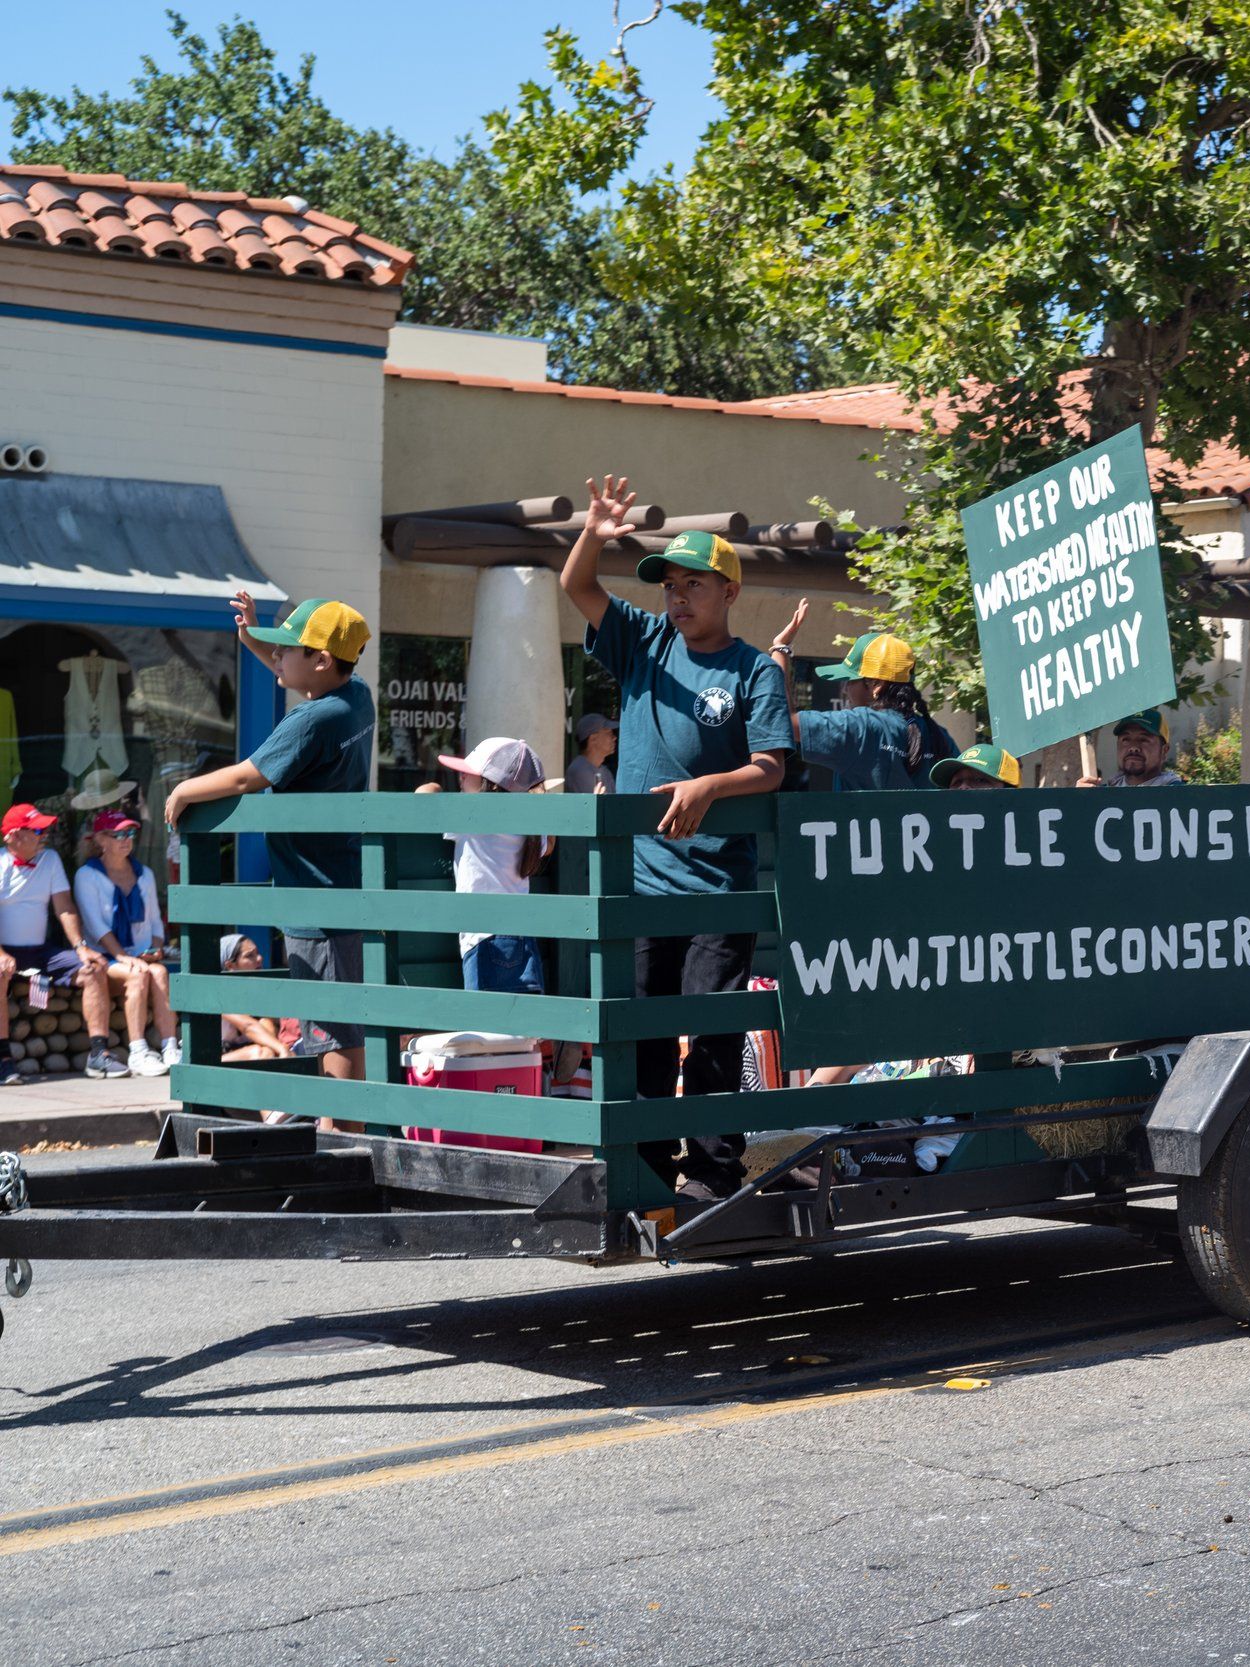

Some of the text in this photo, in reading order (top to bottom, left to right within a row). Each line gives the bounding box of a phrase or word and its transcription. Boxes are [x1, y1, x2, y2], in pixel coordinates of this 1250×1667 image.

[994, 453, 1116, 548] KEEP OUR
[973, 532, 1088, 622] WATERSHED
[1012, 556, 1135, 646] TO KEEP US
[388, 679, 429, 701] OJAI
[1020, 610, 1143, 721] HEALTHY
[390, 709, 456, 730] FRIENDS
[799, 808, 1066, 880] TURTLE
